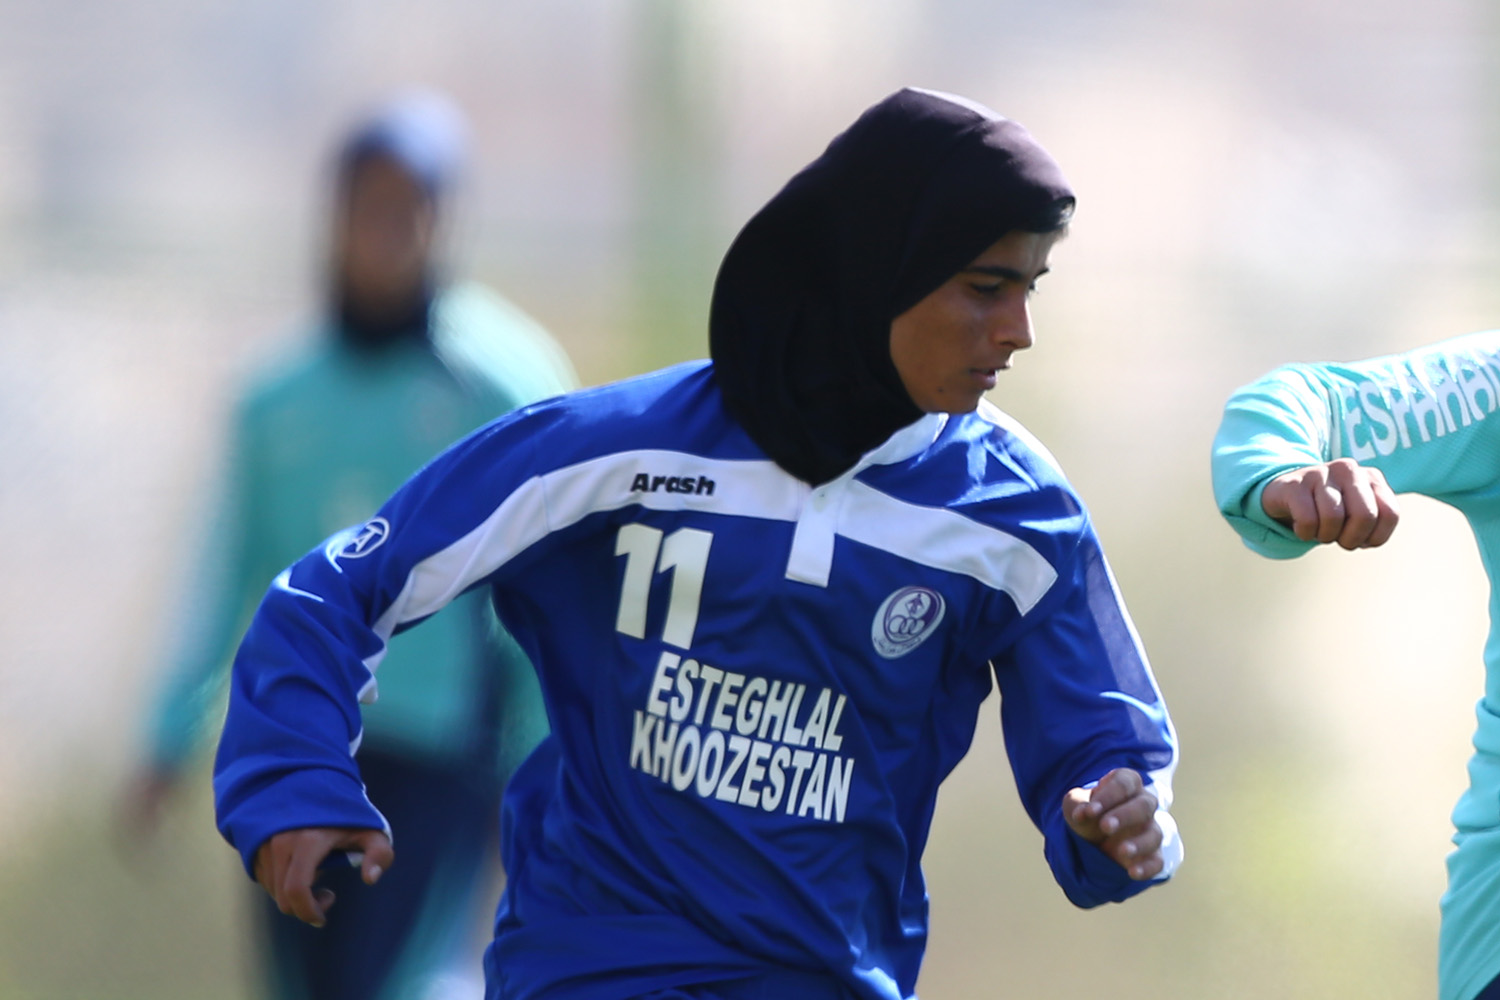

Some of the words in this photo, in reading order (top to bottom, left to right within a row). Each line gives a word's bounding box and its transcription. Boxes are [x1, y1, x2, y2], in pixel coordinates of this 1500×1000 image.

[630, 473, 716, 496] Arash
[615, 523, 713, 650] 11
[647, 651, 848, 751] ESTEGHLAL
[630, 710, 854, 823] KHOOZESTAN
